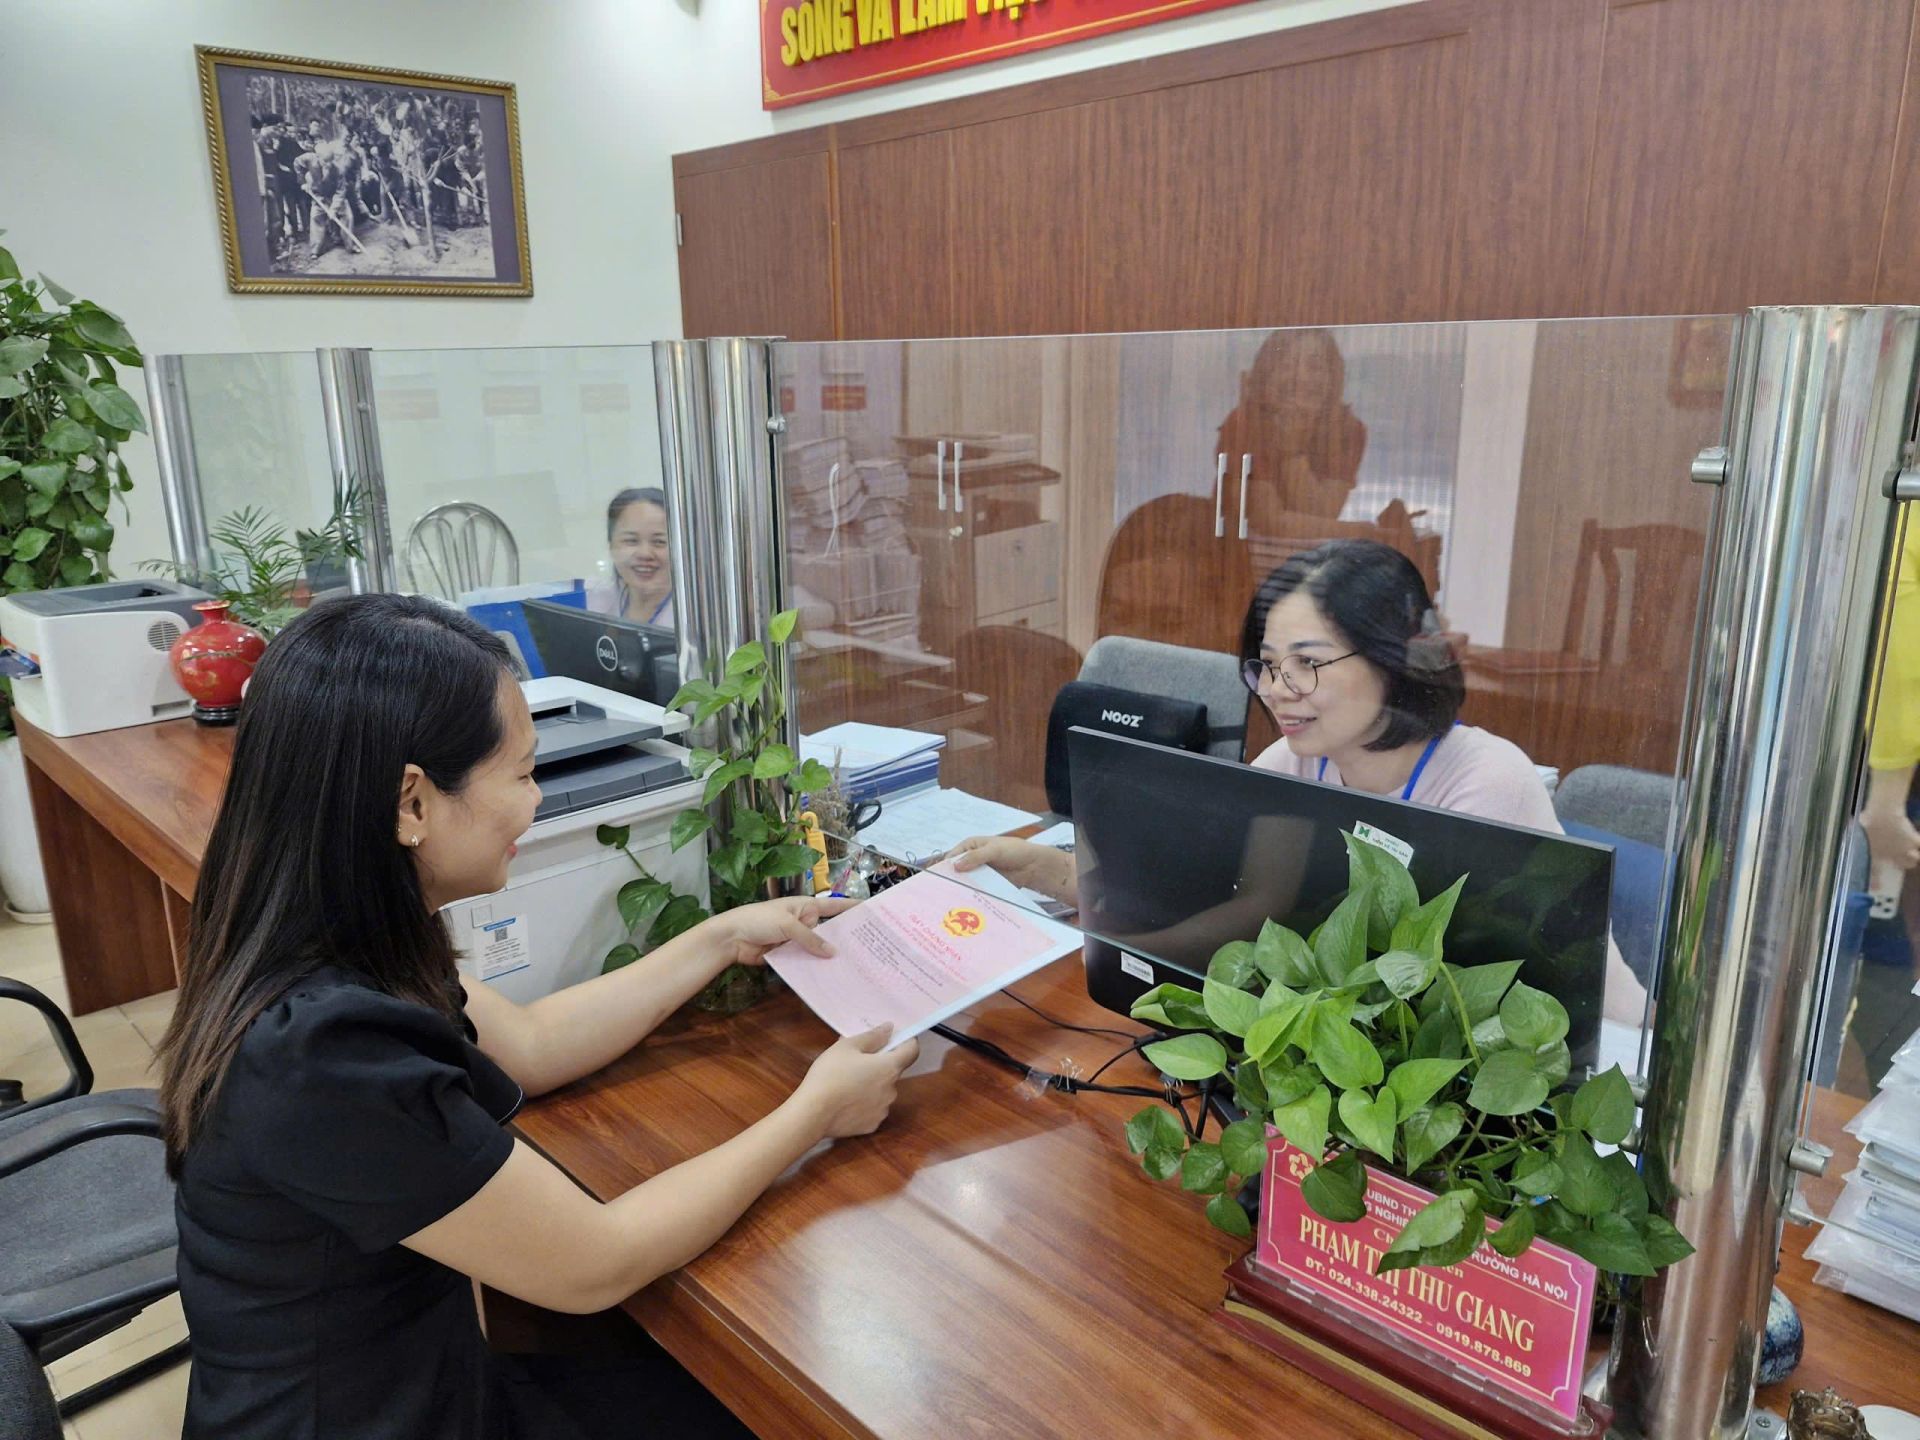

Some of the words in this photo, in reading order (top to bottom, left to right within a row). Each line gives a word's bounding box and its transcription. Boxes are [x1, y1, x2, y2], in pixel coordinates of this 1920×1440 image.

[599, 647, 615, 660] DELL
[1102, 709, 1141, 728] NOOZ
[1367, 1189, 1399, 1210] UBND
[1299, 1214, 1361, 1270] PHẠM
[1407, 1267, 1453, 1312] THU
[1456, 1290, 1535, 1352] GIANG
[1471, 1250, 1520, 1279] RƯỜNG
[1523, 1272, 1541, 1290] HÀ
[1544, 1283, 1568, 1301] NỘI
